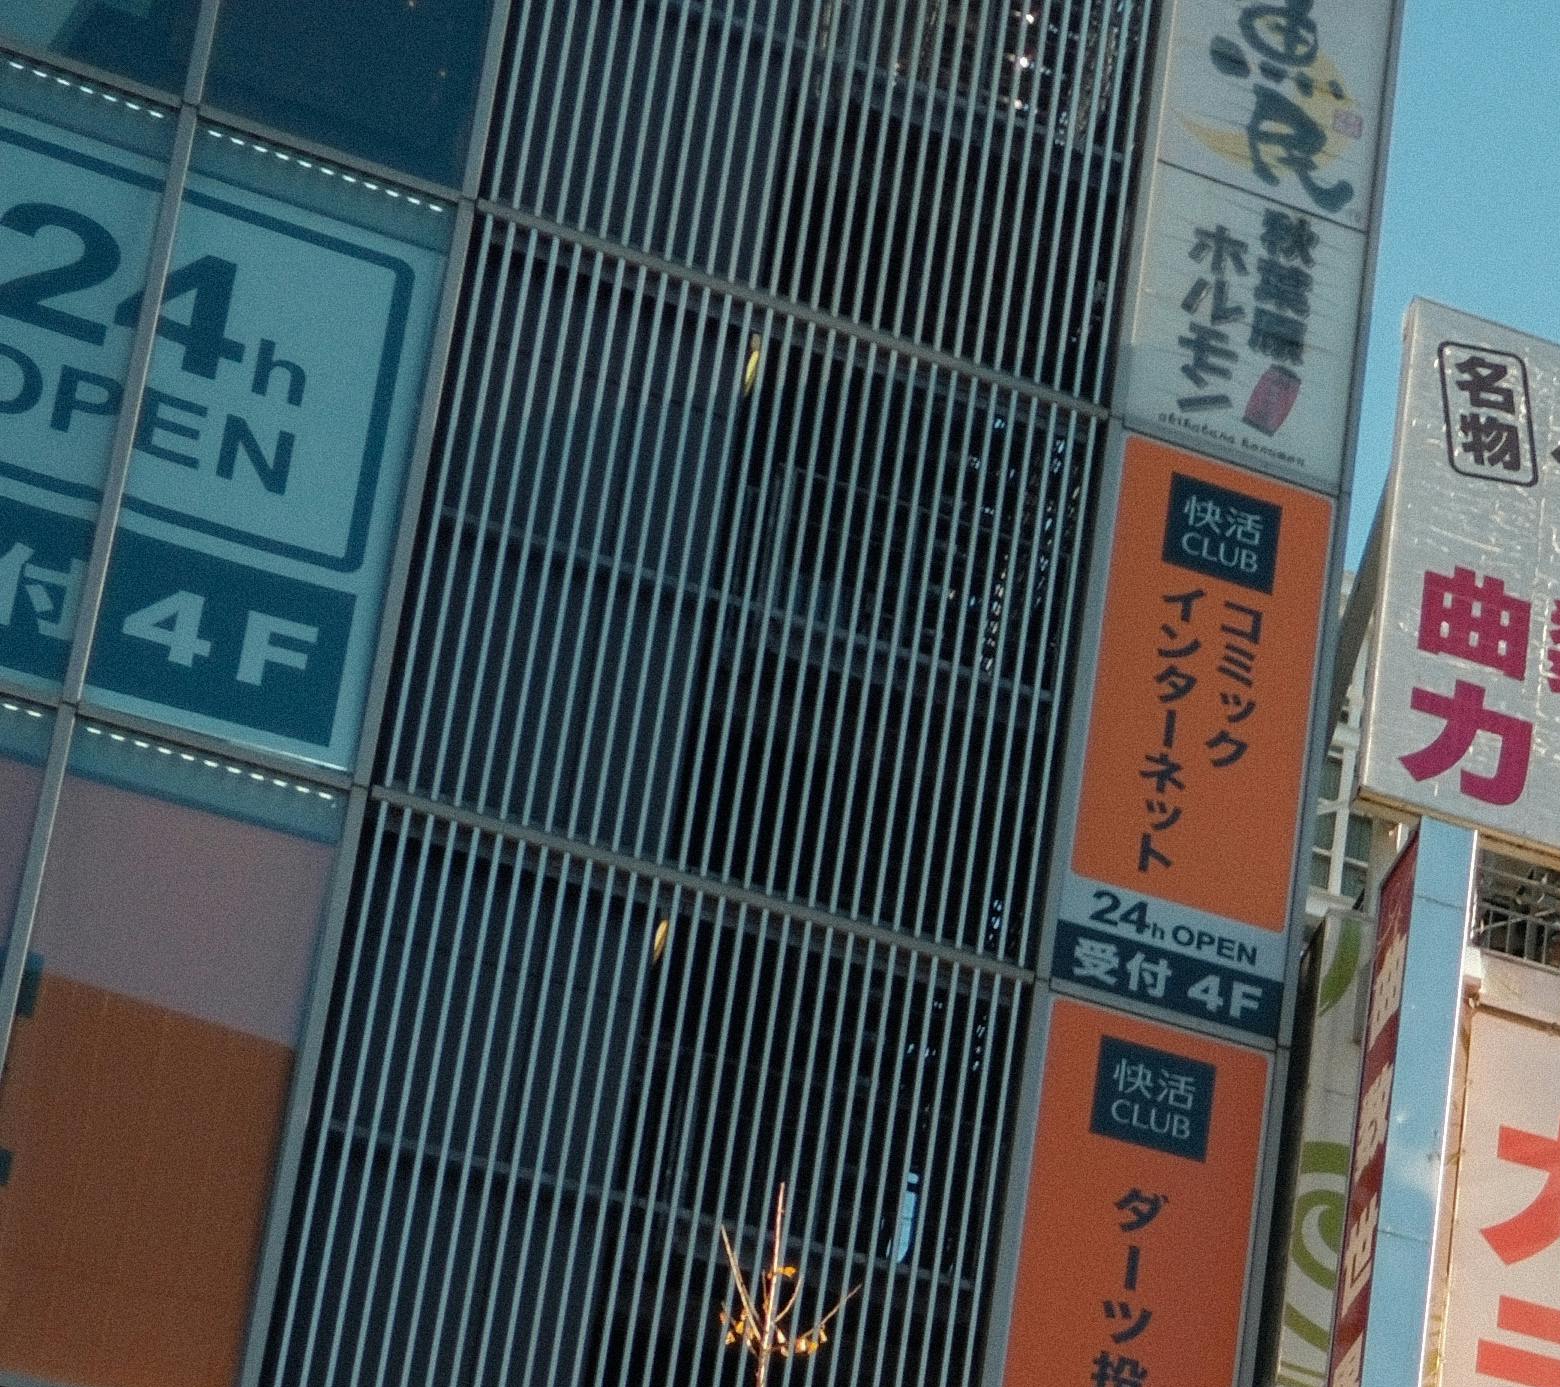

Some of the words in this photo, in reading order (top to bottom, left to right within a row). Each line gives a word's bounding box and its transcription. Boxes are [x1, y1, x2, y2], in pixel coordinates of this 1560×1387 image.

[1176, 225, 1252, 413] ホルモン
[1249, 208, 1322, 366] 秋葉原
[1455, 352, 1525, 474] 名物
[1181, 529, 1259, 576] CLUB
[1183, 494, 1265, 548] 快活
[122, 589, 320, 687] 4F
[1203, 599, 1265, 768] コミック
[1136, 588, 1207, 875] インターネット
[1090, 890, 1165, 943] 24h
[1171, 921, 1258, 968] OPEN
[1072, 935, 1173, 998] 受付
[1187, 966, 1263, 1020] 4F
[1110, 1099, 1191, 1142] CLUB
[1112, 1056, 1198, 1111] 快活
